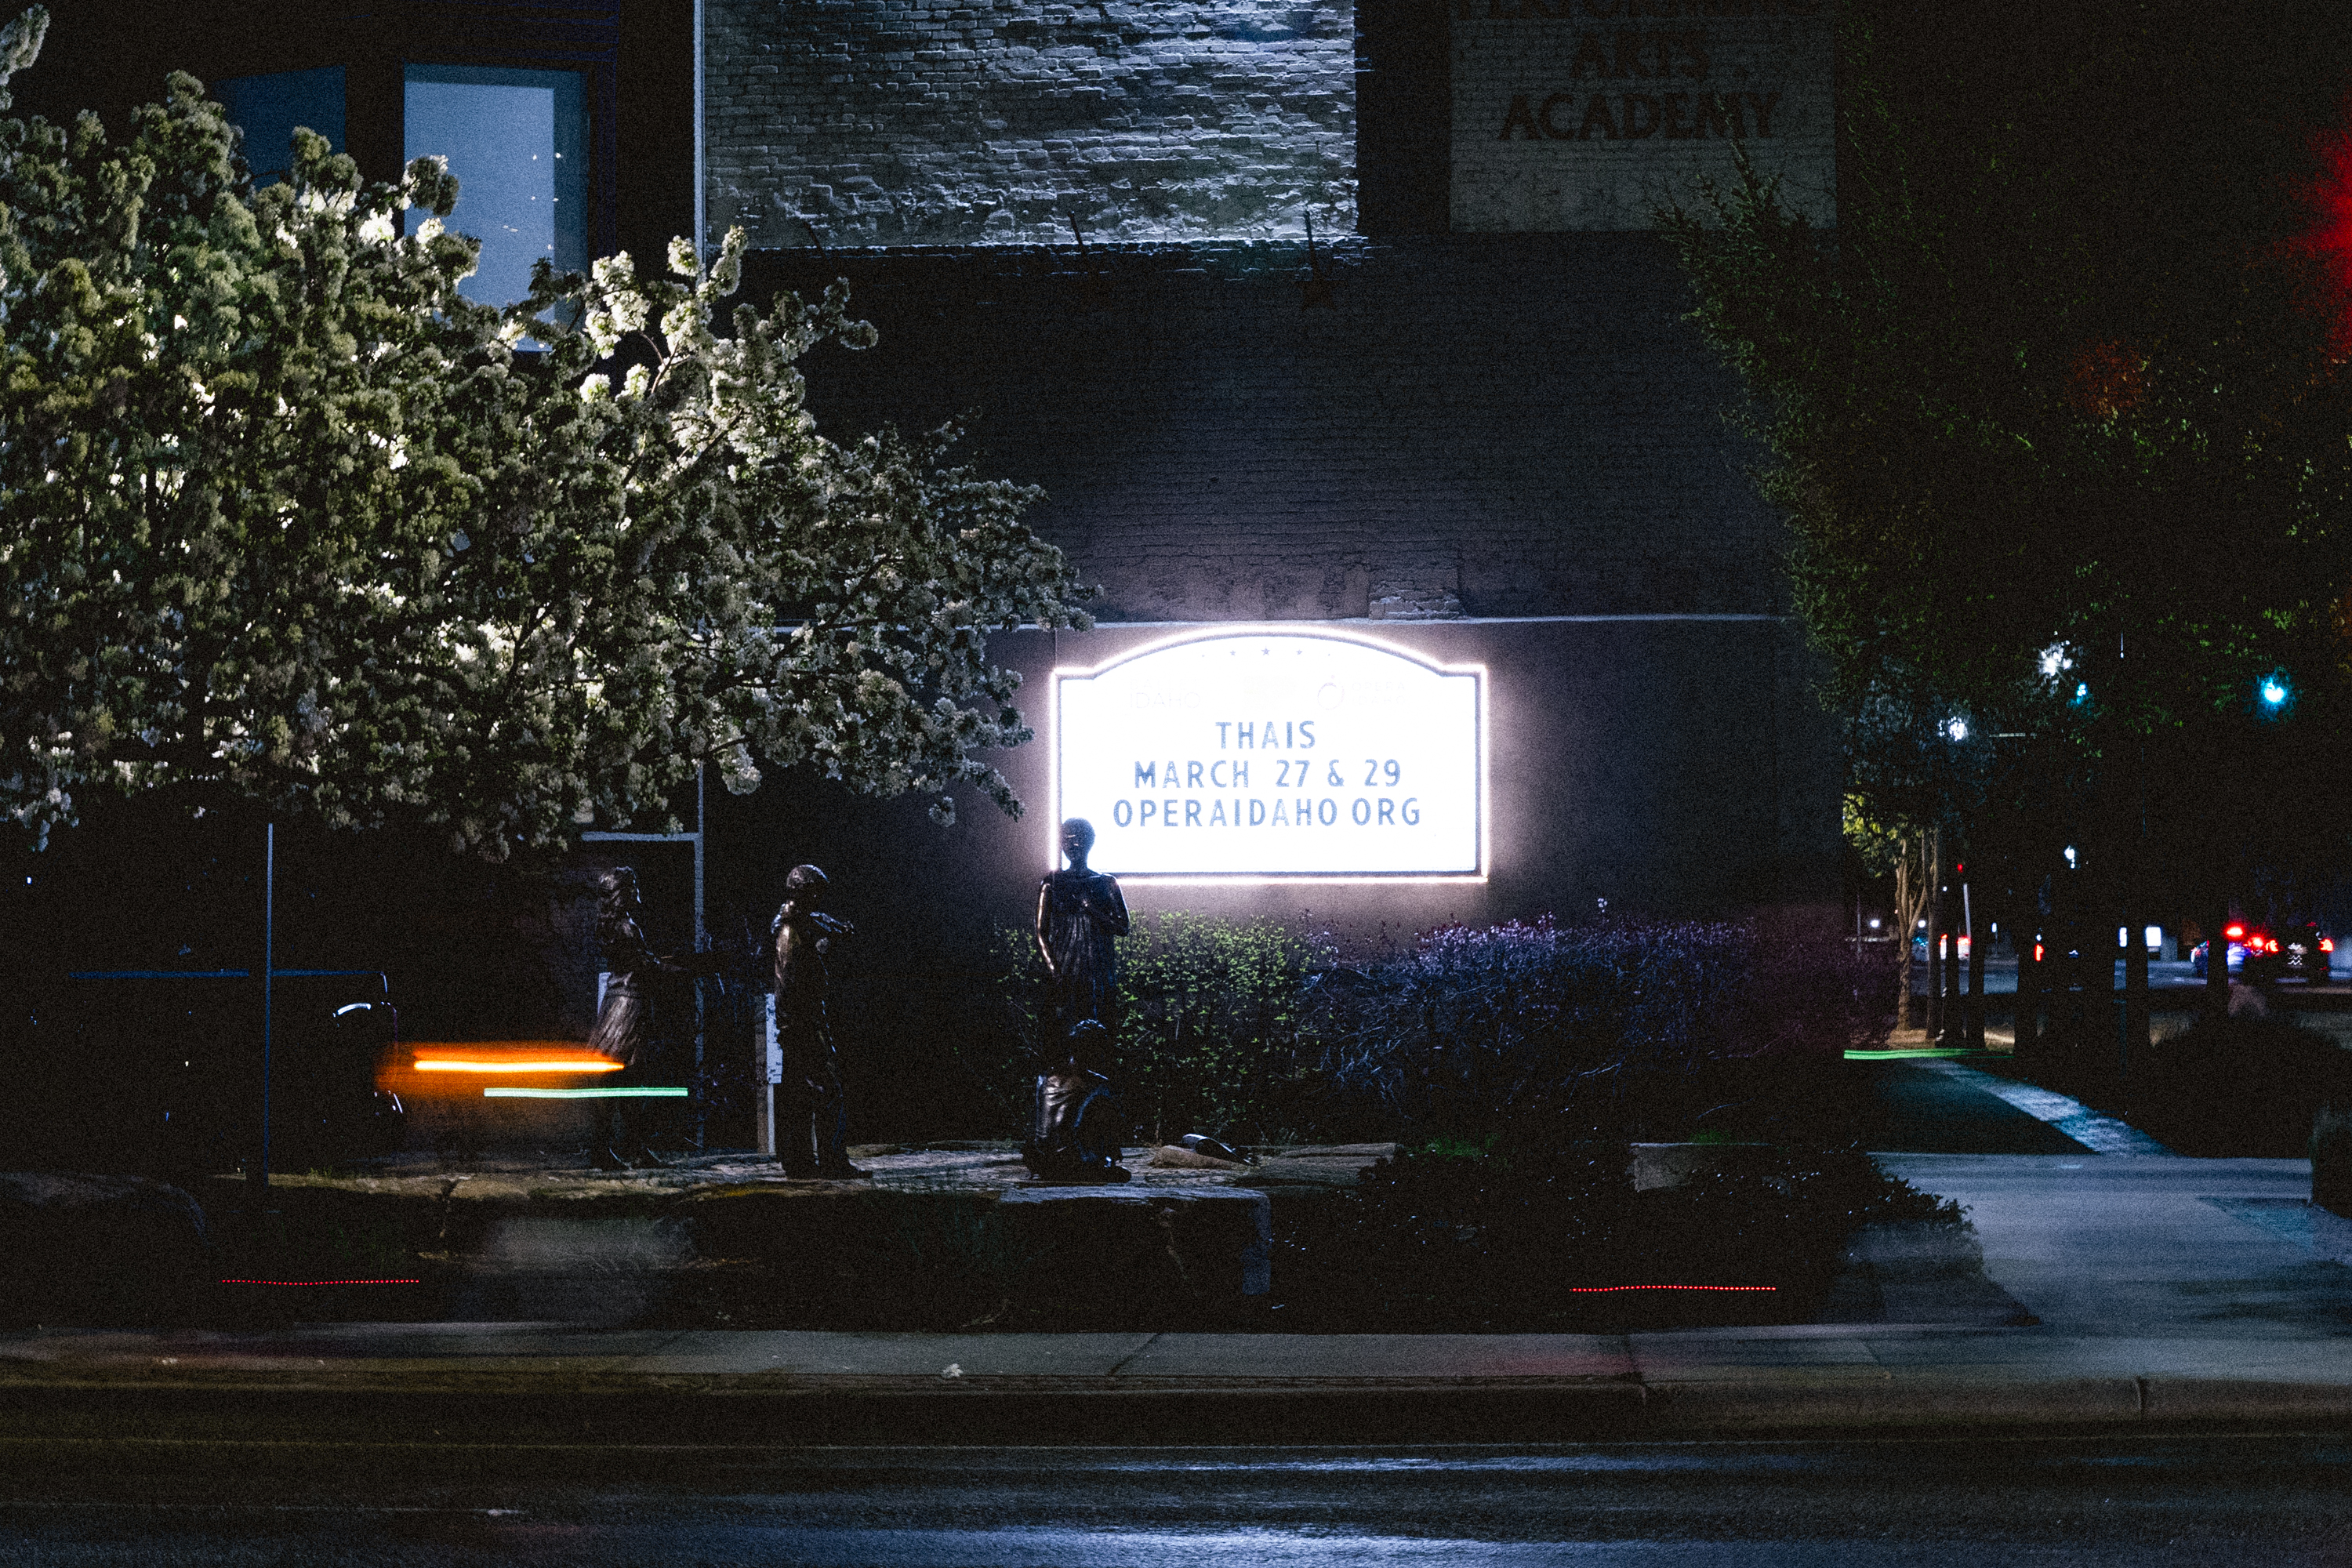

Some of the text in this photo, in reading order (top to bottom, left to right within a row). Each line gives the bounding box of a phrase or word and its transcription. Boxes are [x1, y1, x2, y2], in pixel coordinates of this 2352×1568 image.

[1570, 31, 1711, 79] ARTS
[1499, 92, 1782, 140] ACADEMY
[1130, 691, 1201, 709] IDAHO
[1351, 681, 1406, 692] OPERA
[1215, 720, 1316, 750] THAIS
[1134, 758, 1401, 788] MARCH 27 & 29
